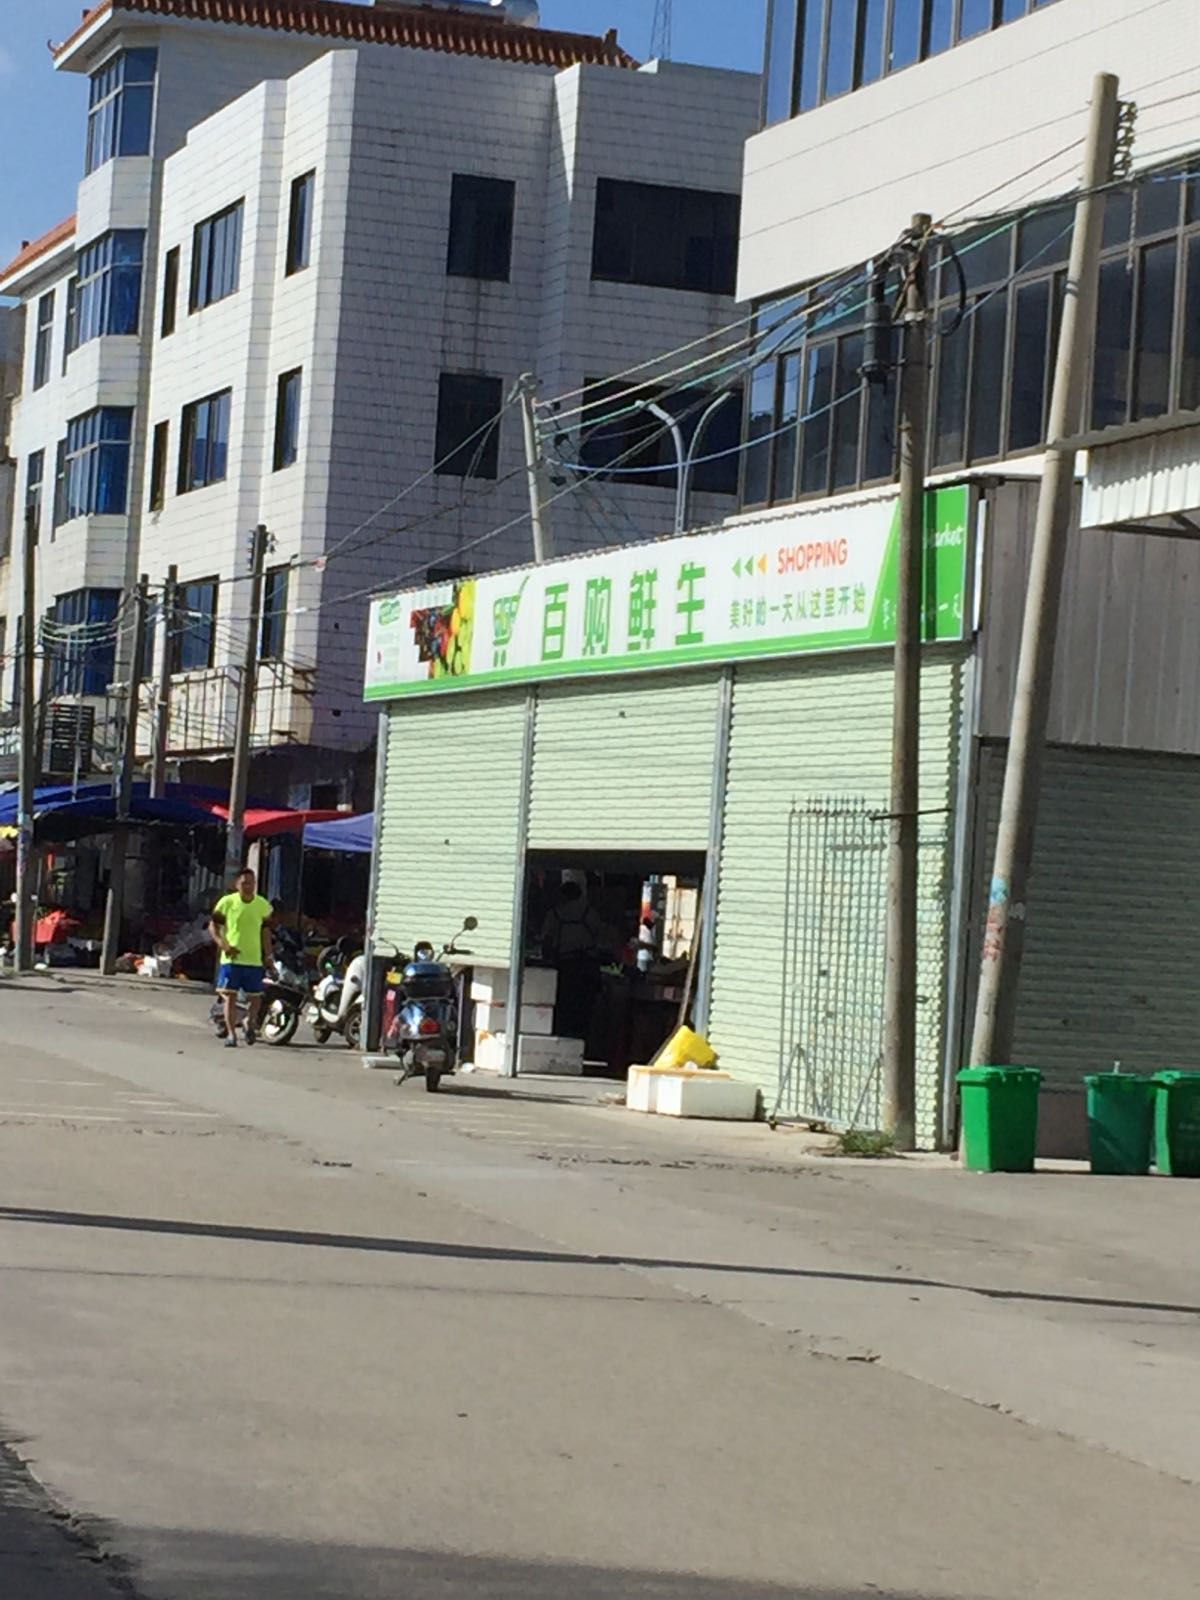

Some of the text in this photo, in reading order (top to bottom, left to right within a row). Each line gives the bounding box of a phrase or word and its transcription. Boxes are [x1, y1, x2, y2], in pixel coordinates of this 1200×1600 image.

[777, 537, 848, 575] SHOPPING
[541, 561, 706, 661] 百购鲜生
[729, 581, 866, 630] 美好的一天从这里开始
